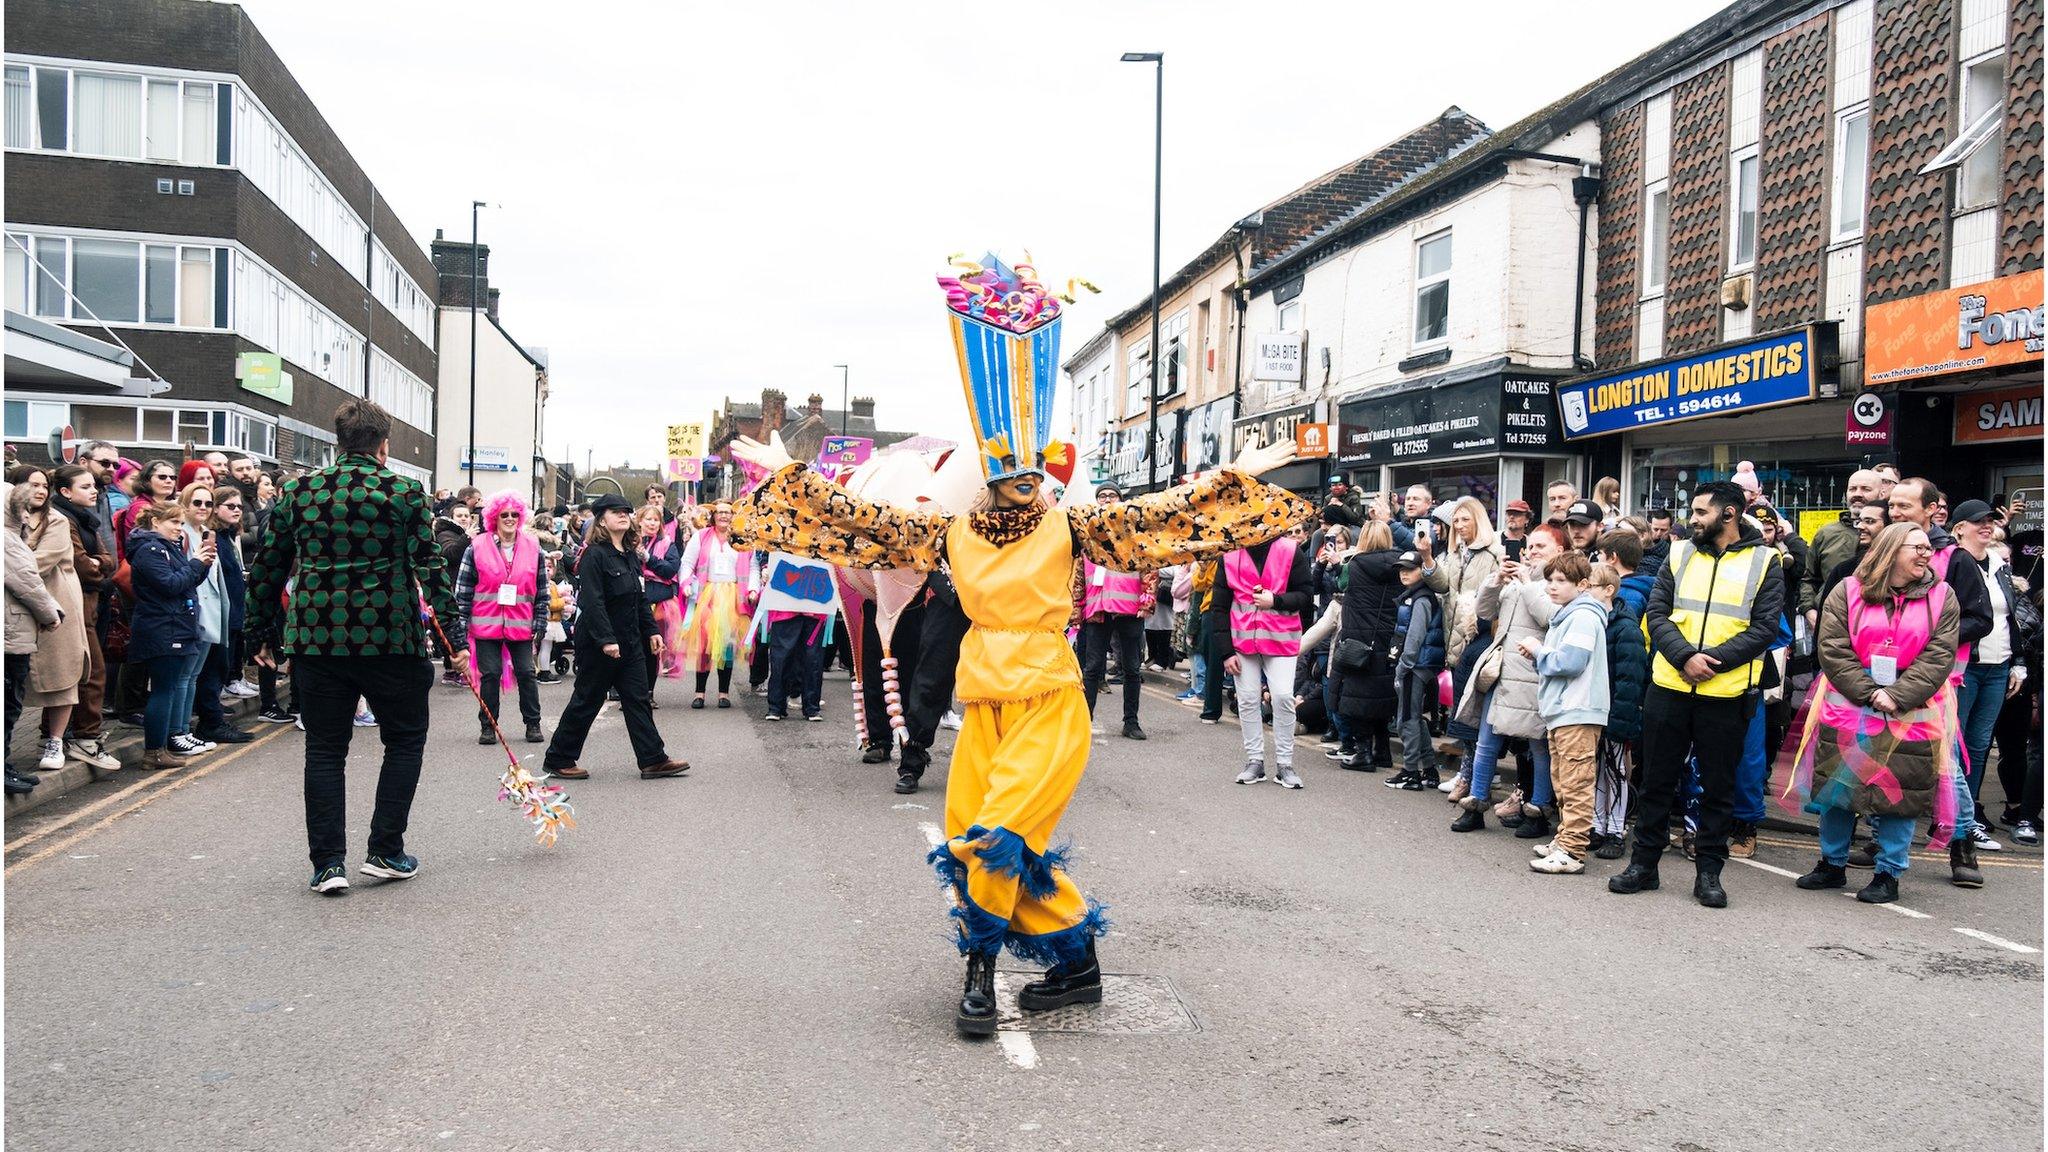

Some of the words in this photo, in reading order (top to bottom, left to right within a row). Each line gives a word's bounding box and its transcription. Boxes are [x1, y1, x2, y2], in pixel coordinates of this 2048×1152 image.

[1283, 345, 1298, 359] BITE
[1871, 357, 1985, 381] www.thefoneshoponline.com
[1588, 370, 1670, 415] LONGTON
[1677, 341, 1804, 396] DOMESTICS
[1505, 380, 1550, 395] OATCAKES
[1522, 397, 1530, 410] &
[1634, 406, 1665, 422] TEL
[1679, 391, 1742, 415] 594614
[1507, 413, 1546, 427] PIKELETS
[1373, 429, 1390, 441] BAKED
[1396, 425, 1413, 437] FILLED
[1414, 420, 1444, 435] OATCAKES
[1450, 415, 1479, 430] PIKELETS
[1505, 432, 1518, 444] Tel
[1519, 432, 1547, 445] 372555
[1847, 430, 1887, 442] payzone
[480, 449, 506, 458] Hanley
[1392, 441, 1403, 456] Tel
[1404, 439, 1429, 455] 372555
[2025, 500, 2044, 510] PENI
[2015, 523, 2034, 532] MON
